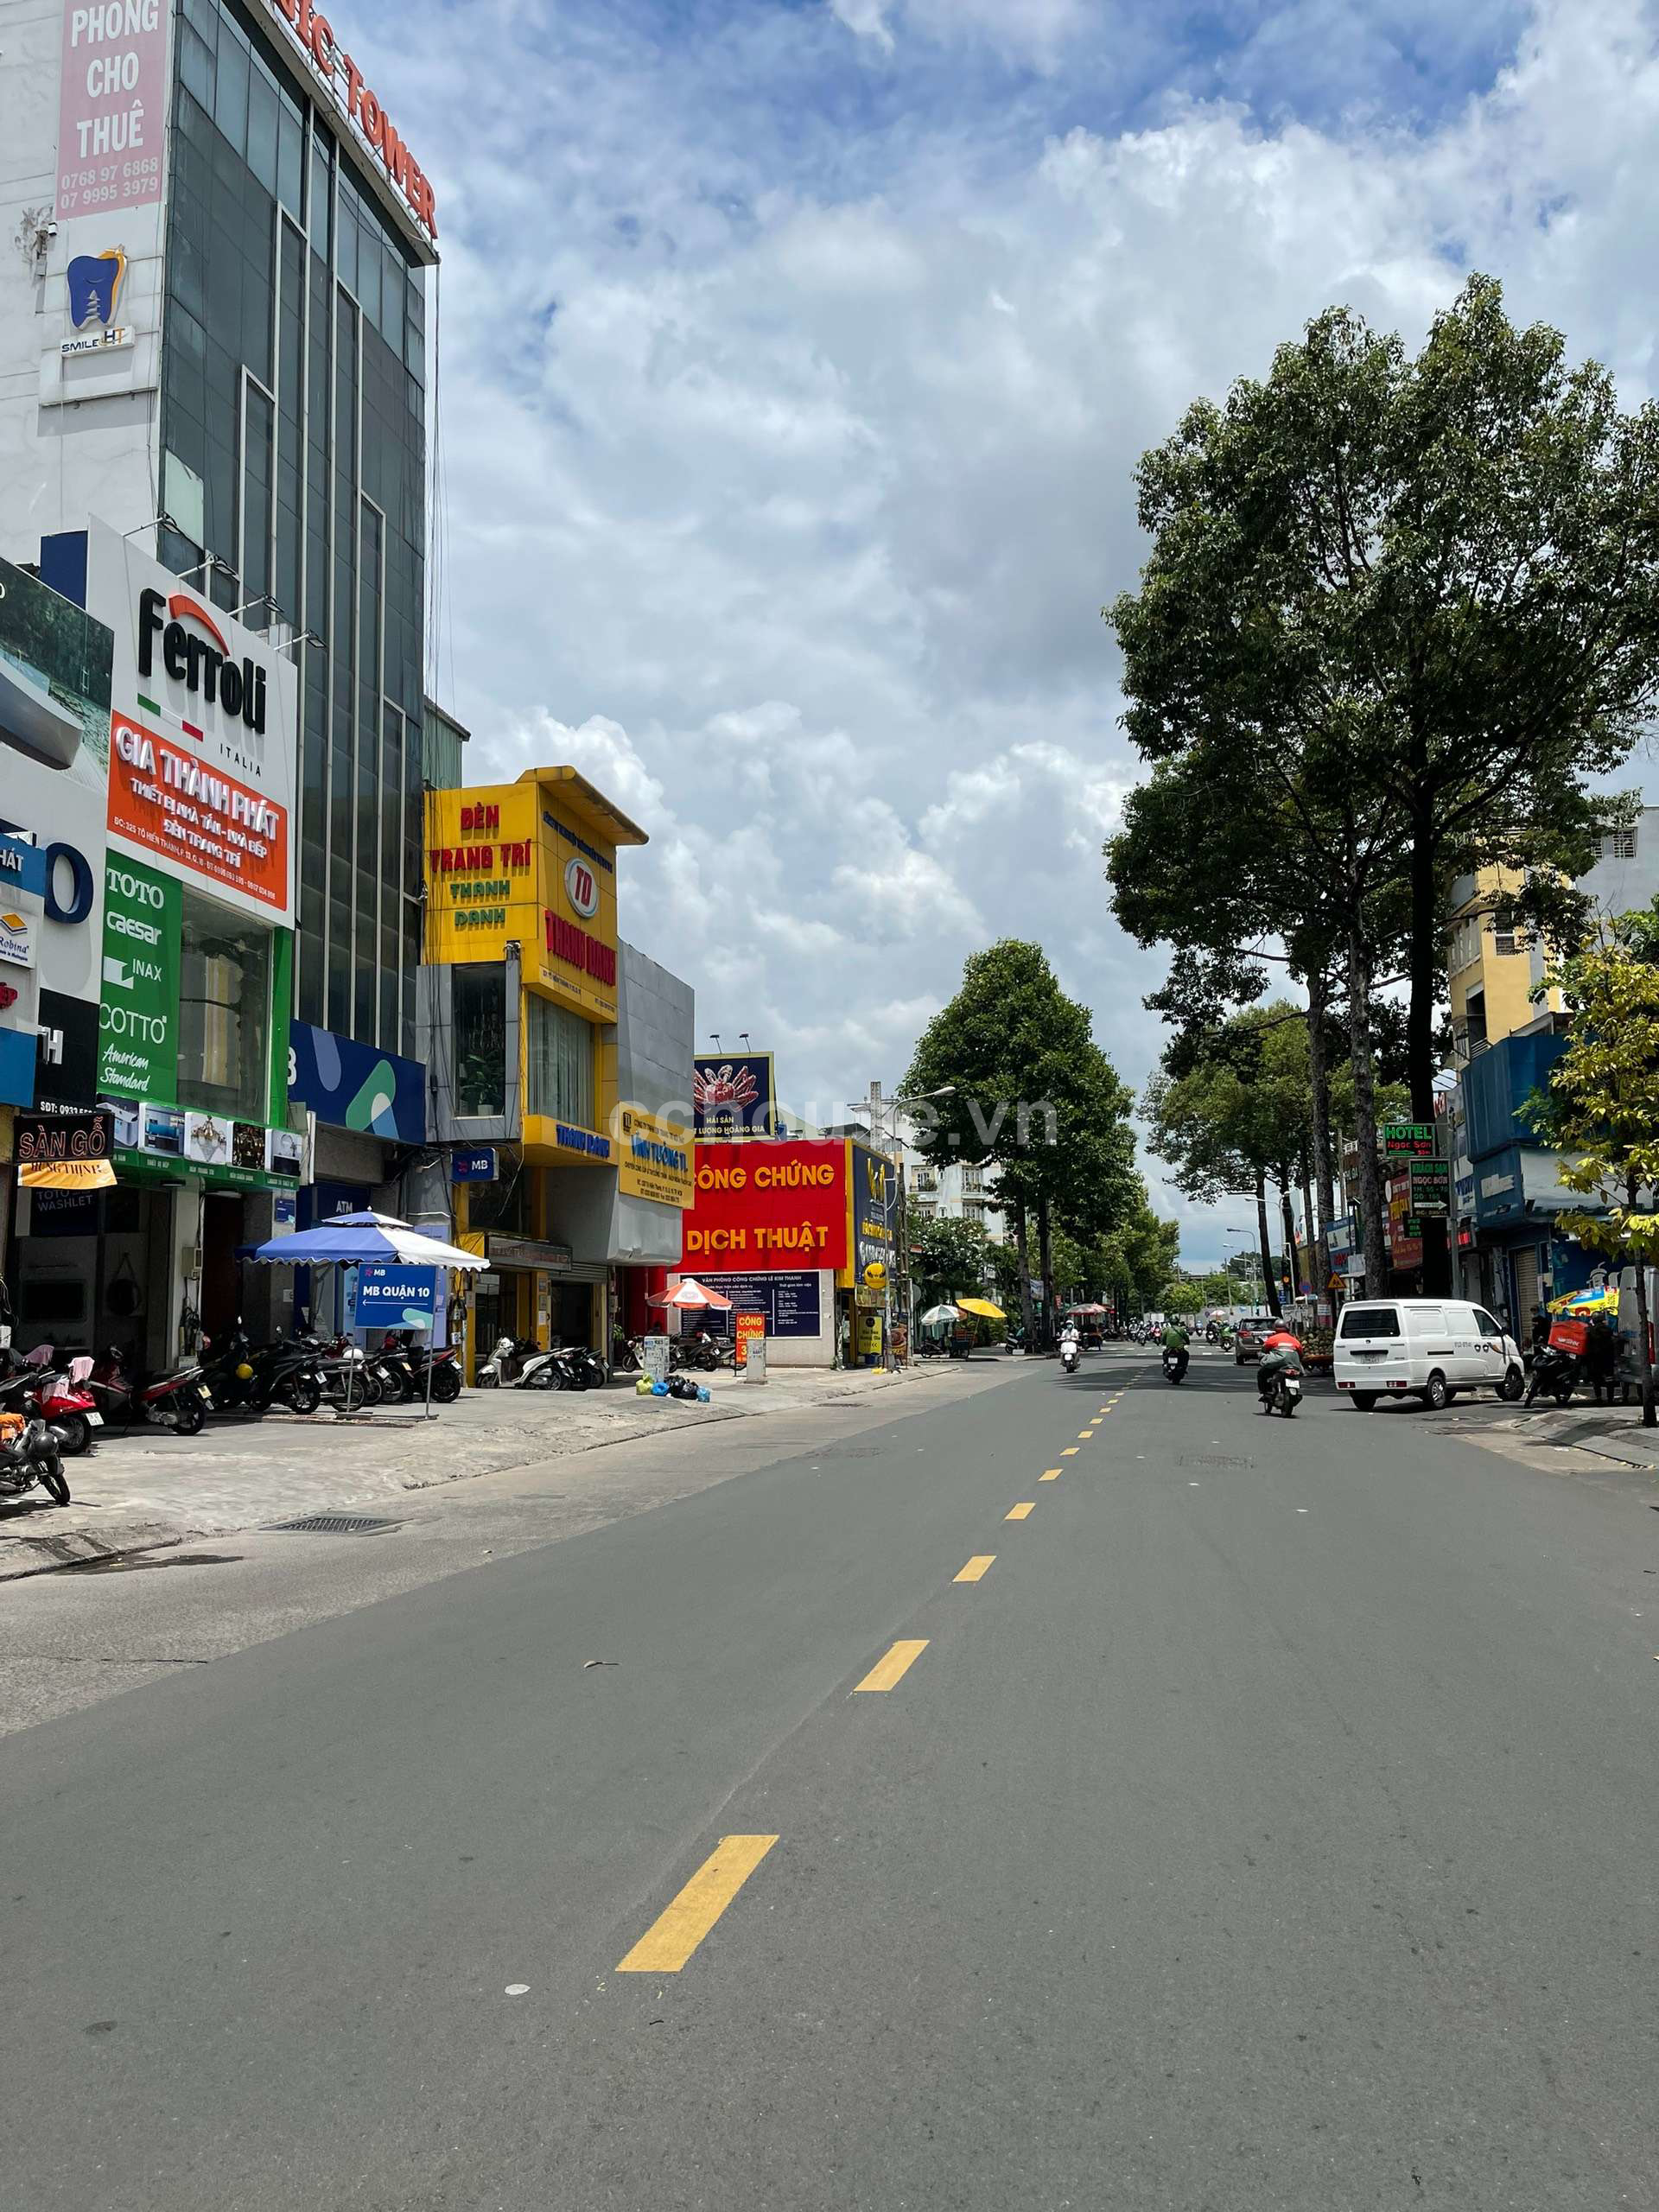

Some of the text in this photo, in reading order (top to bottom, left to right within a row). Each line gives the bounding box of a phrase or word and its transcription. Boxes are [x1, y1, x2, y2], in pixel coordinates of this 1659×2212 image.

[86, 52, 139, 98] CHO
[76, 99, 144, 158] THUÊ
[343, 54, 438, 239] TOWER
[60, 157, 159, 190] 0768 97 6868
[60, 176, 159, 209] 07 9995 3979
[61, 339, 99, 353] SMILE
[139, 588, 267, 734] Ferroli
[220, 743, 261, 777] ITALIA
[116, 726, 280, 841] GIA THÀNH PHÁT
[460, 801, 499, 830] ĐÈN
[187, 830, 223, 859] TRANG
[223, 849, 242, 868] TRÍ
[429, 846, 493, 873] TRANG
[500, 838, 532, 868] TRÍ
[106, 867, 164, 909] TOTO
[450, 880, 511, 899] THANH
[575, 865, 593, 906] TD
[454, 907, 506, 927] DANH
[132, 957, 162, 982] INAX
[99, 1002, 166, 1044] COTTO
[102, 1043, 149, 1071] American
[99, 1067, 150, 1092] Standard
[19, 1116, 106, 1159] SÀN GỖ
[724, 1124, 750, 1134] HOÀNG
[1385, 1126, 1433, 1140] HOTEL
[471, 1160, 488, 1170] MB
[754, 1159, 836, 1187] CHỨNG
[38, 1195, 93, 1211] WASHLET
[335, 1200, 353, 1213] ATM
[687, 1229, 747, 1255] DỊCH
[753, 1221, 829, 1253] THUẬT
[363, 1284, 430, 1300] MB QUẬN 10
[737, 1328, 764, 1339] CHỨNG
[739, 1315, 762, 1325] CÔNG
